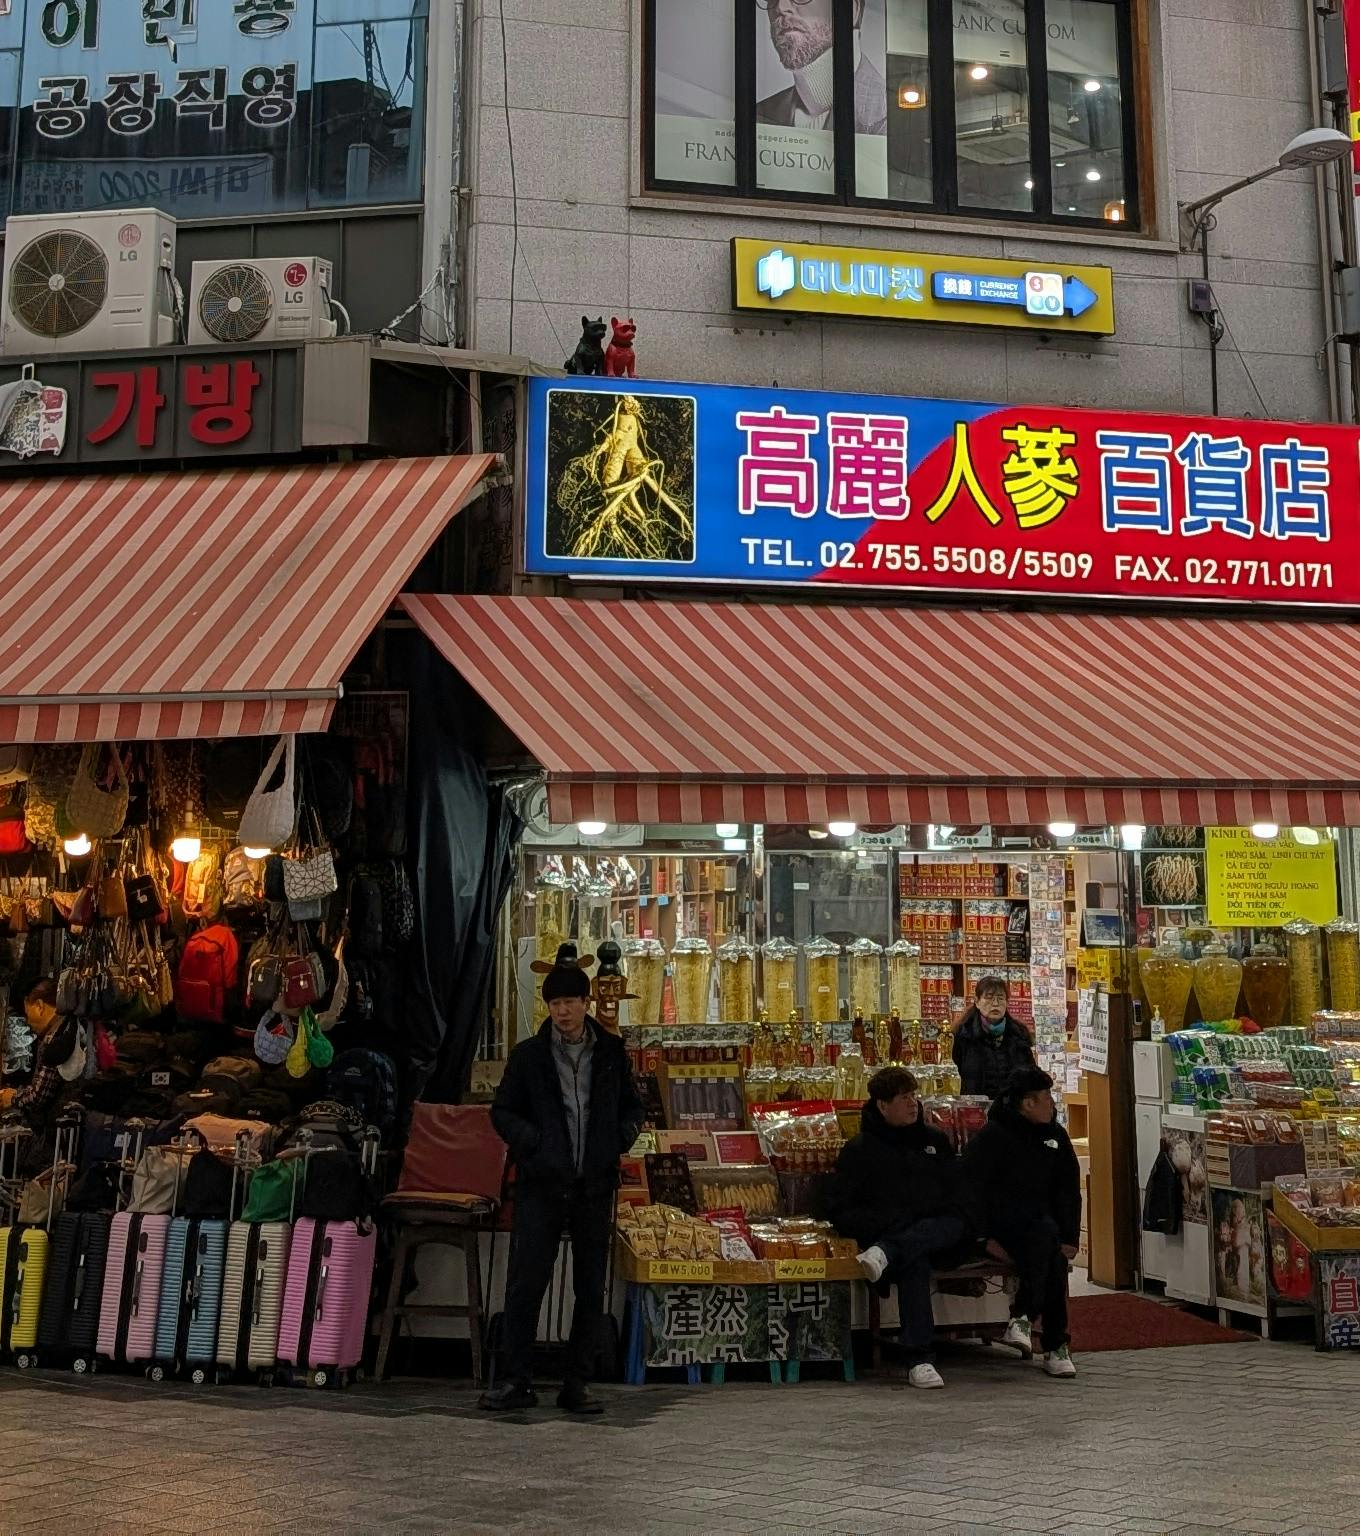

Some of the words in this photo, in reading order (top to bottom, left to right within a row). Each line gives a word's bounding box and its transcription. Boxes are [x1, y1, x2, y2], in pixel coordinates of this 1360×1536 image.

[33, 62, 298, 139] 공장직영
[684, 141, 737, 161] FRAN
[119, 250, 138, 262] LG
[285, 291, 304, 304] LG
[800, 258, 924, 303] 머니마켓
[85, 359, 262, 450] 가방
[733, 405, 1332, 543] 高麗人蔘百貨店
[740, 538, 814, 569] TEL.
[820, 540, 1094, 582] 02.755.5508/5509
[1115, 555, 1180, 584] FAX.
[1185, 556, 1335, 590] 02.771.0171
